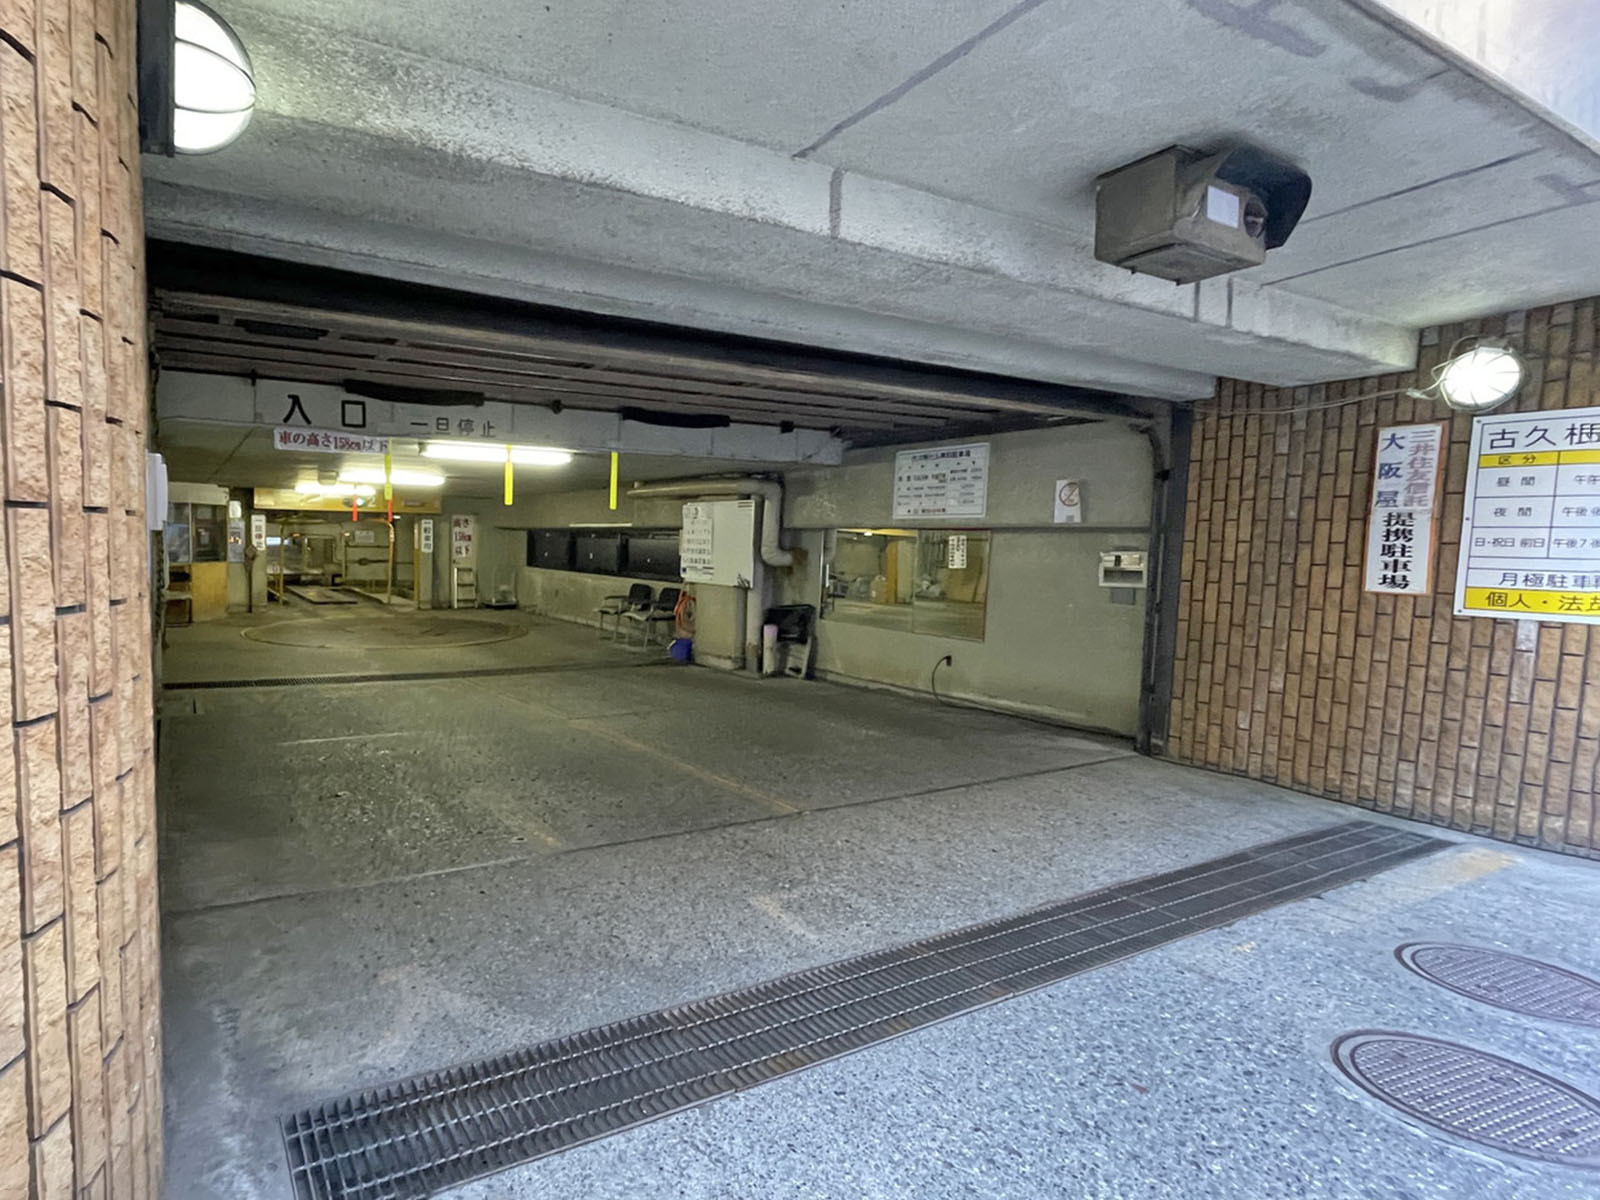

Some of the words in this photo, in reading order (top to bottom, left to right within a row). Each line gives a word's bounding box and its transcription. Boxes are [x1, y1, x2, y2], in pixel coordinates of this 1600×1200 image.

[283, 394, 366, 428] 入口
[410, 417, 496, 438] 一旦停止
[1375, 432, 1405, 508] 大阪屋
[1498, 454, 1536, 465] 区分
[1496, 476, 1535, 487] 昼間
[1493, 507, 1532, 517] 夜間
[1378, 512, 1416, 590] 提携駐車場
